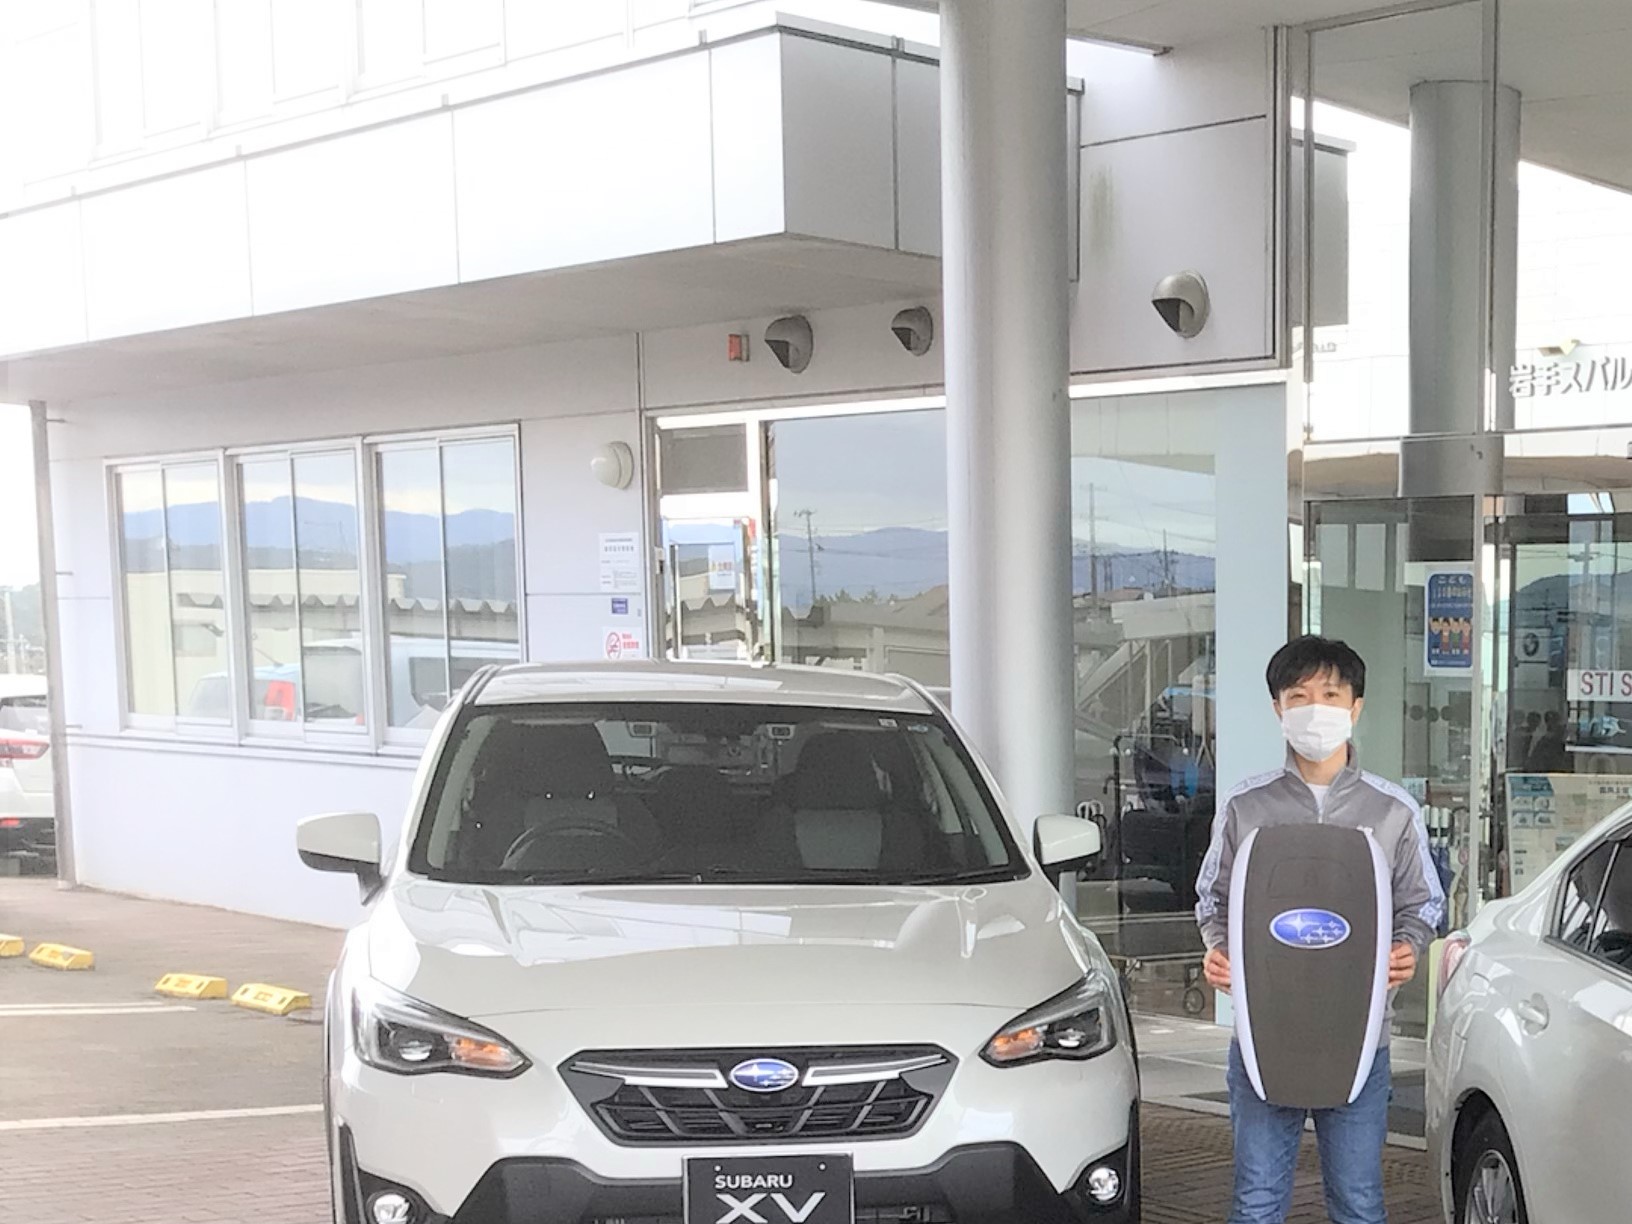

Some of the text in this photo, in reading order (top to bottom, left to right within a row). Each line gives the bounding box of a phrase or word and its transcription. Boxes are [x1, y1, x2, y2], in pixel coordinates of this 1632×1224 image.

[1580, 671, 1614, 696] STI
[715, 1174, 793, 1189] SUBARU
[715, 1191, 826, 1224] XV
